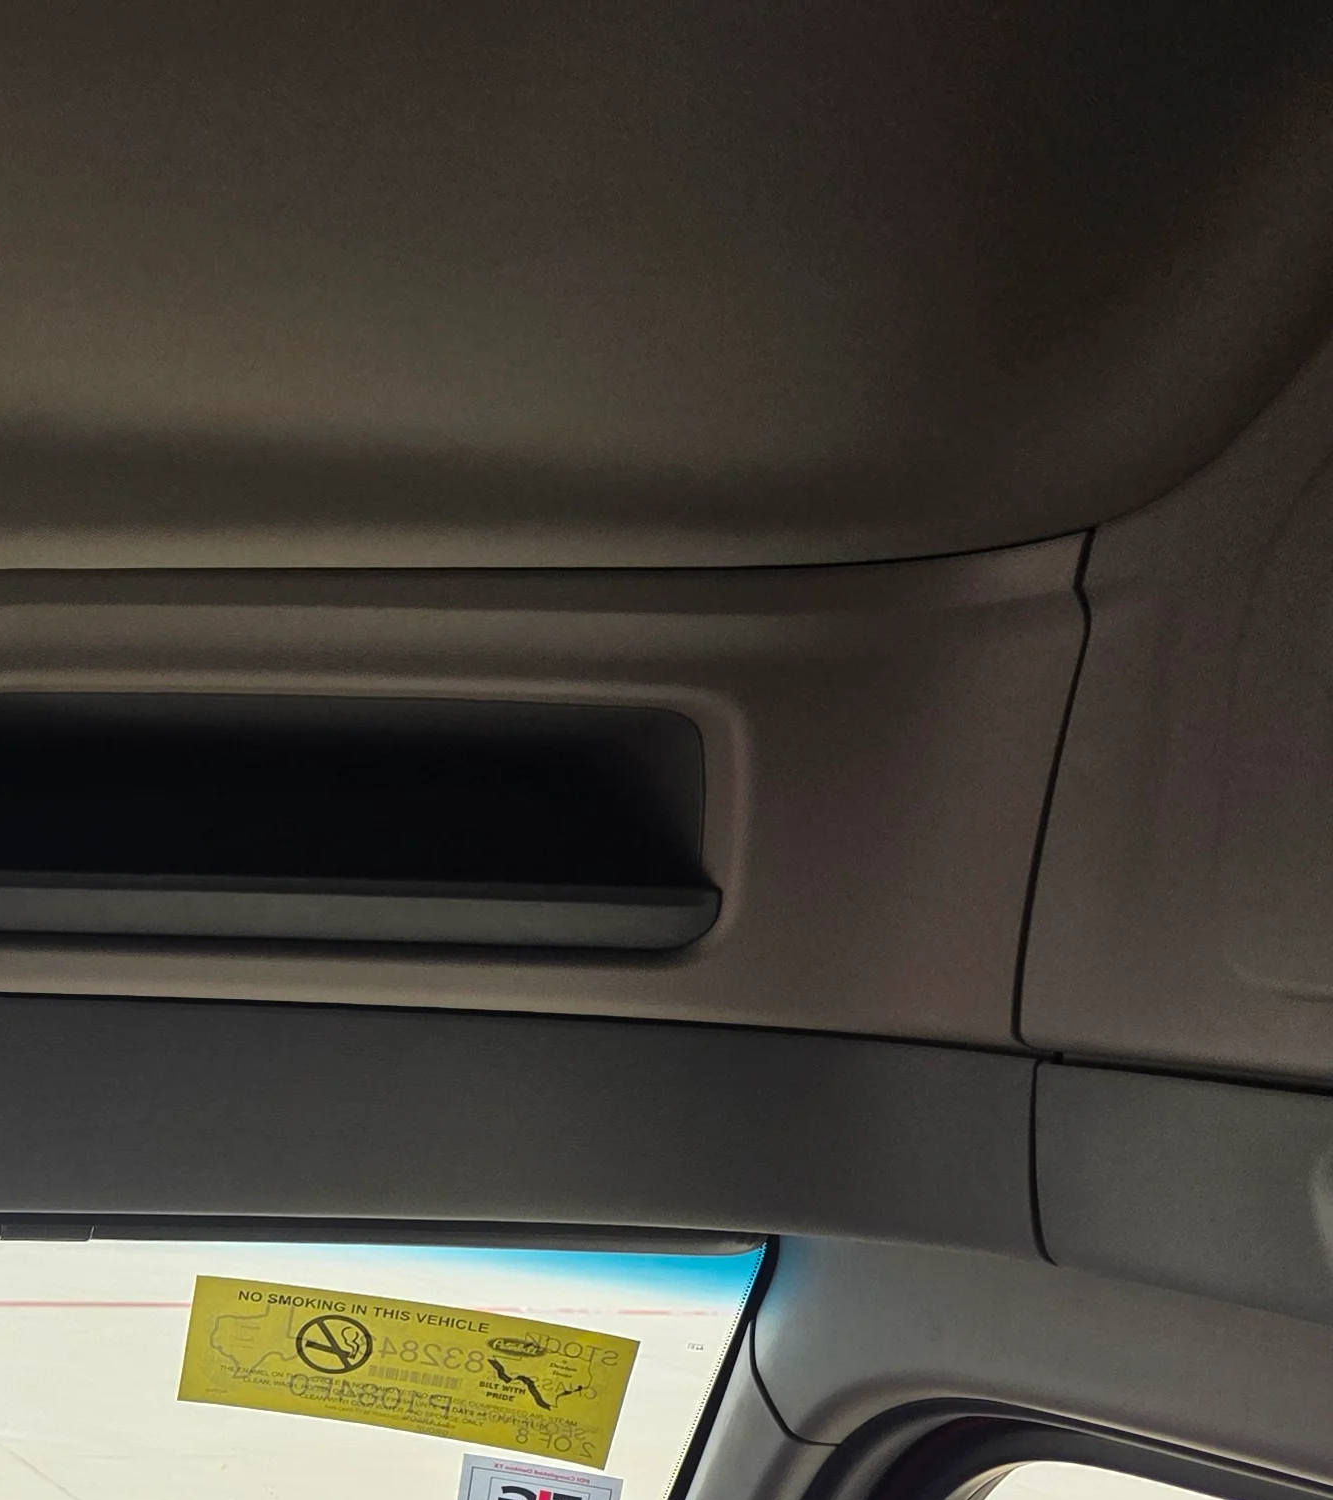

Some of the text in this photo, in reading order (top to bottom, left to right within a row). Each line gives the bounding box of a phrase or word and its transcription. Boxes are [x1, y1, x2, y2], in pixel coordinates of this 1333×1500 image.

[238, 1290, 490, 1334] NO SMOKING IN THIS VEHICLE
[479, 1381, 526, 1396] BILT WITH
[486, 1392, 515, 1402] PRIDE
